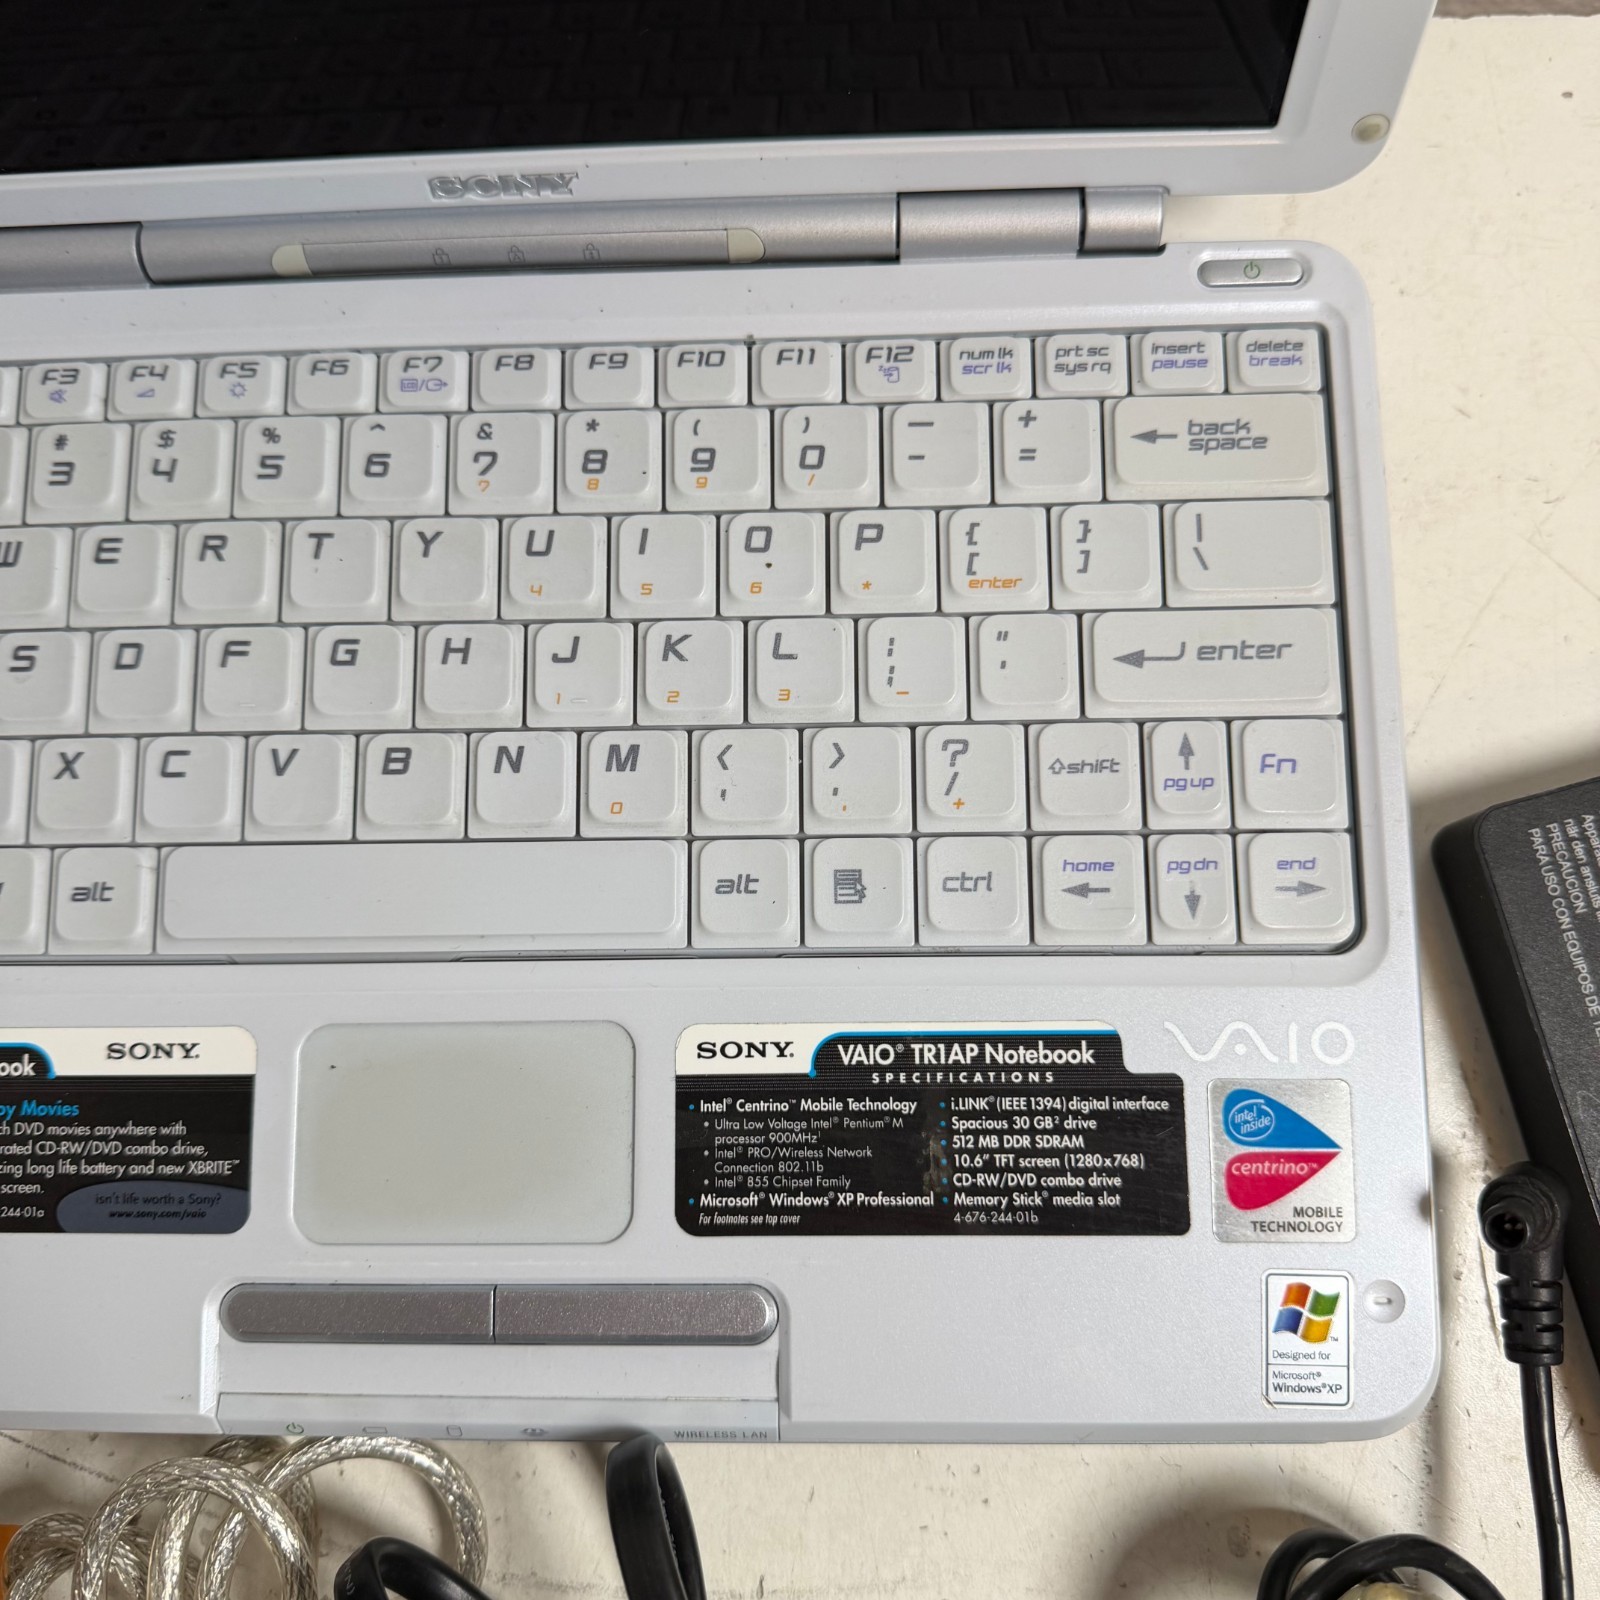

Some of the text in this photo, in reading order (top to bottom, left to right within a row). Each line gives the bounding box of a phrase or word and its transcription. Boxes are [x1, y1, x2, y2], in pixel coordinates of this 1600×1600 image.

[427, 171, 579, 199] SONY
[960, 347, 1013, 360] num lk
[1055, 345, 1109, 360] prt sc
[1151, 342, 1205, 354] insert
[1246, 340, 1304, 352] delete
[495, 354, 535, 371] F8
[589, 352, 628, 369] F9
[678, 350, 725, 367] F10
[777, 348, 815, 365] F11
[866, 346, 914, 363] F12
[1249, 354, 1302, 366] break
[219, 362, 259, 378] F5
[310, 359, 349, 376] F6
[403, 356, 443, 373] F7
[962, 361, 1012, 374] scr lk
[1054, 362, 1111, 375] sys rq
[1152, 359, 1208, 372] pause
[41, 368, 80, 385] F3
[129, 365, 169, 382] F4
[1188, 419, 1250, 436] back
[1188, 435, 1268, 455] space
[417, 531, 443, 558] Y
[526, 530, 555, 556] U
[855, 524, 884, 550] P
[94, 538, 123, 564] E
[199, 535, 228, 561] R
[308, 533, 334, 559] T
[968, 577, 1022, 588] enter
[220, 641, 251, 667] F
[662, 635, 692, 661] K
[1197, 640, 1292, 661] enter
[494, 746, 524, 773] N
[606, 744, 640, 772] M
[1067, 758, 1120, 774] shift
[1260, 754, 1297, 773] Fn
[1164, 778, 1214, 791] pg up
[1563, 818, 1587, 864] när den
[1063, 860, 1115, 872] home
[1167, 858, 1218, 874] pg dn
[1277, 857, 1316, 870] end
[1546, 822, 1587, 914] PRECAUCION
[715, 874, 759, 894] alt
[943, 871, 992, 892] ctrl
[71, 882, 114, 902] alt
[1528, 827, 1594, 995] PARA USO CON EQUIPOS
[1163, 1021, 1355, 1065] VAIO
[911, 1043, 978, 1065] TR1AP
[985, 1041, 1096, 1065] Notebook
[872, 1071, 1054, 1083] SPECIFICATIONS
[20, 1101, 80, 1115] Movies
[801, 1099, 843, 1111] Mobile
[847, 1098, 917, 1114] Technology
[997, 1098, 1028, 1112] (IEEE
[1030, 1097, 1066, 1112] 1394)
[1069, 1096, 1109, 1114] digital
[1113, 1096, 1169, 1111] interface
[1234, 1106, 1257, 1124] intel
[13, 1123, 44, 1135] DVD
[47, 1122, 91, 1135] movies
[93, 1121, 157, 1138] anywhere
[160, 1120, 186, 1134] with
[715, 1119, 740, 1129] Ultra
[744, 1119, 765, 1129] Low
[768, 1119, 807, 1132] Voltage
[892, 1118, 903, 1127] M
[952, 1117, 1008, 1131] Spacious
[1013, 1116, 1029, 1129] 30
[1064, 1116, 1097, 1130] drive
[1240, 1116, 1271, 1134] inside
[715, 1134, 765, 1146] processor
[952, 1135, 1085, 1148] 512 MB DDR SDRAM
[35, 1141, 122, 1156] CD-RW/DVD
[125, 1141, 168, 1155] combo
[171, 1141, 208, 1156] drive,
[748, 1146, 823, 1158] PRO/Wireless
[827, 1147, 872, 1157] Network
[26, 1160, 54, 1177] long
[57, 1160, 78, 1173] life
[81, 1160, 126, 1177] battery
[129, 1160, 154, 1174] and
[157, 1163, 186, 1173] new
[715, 1161, 824, 1172] Connection 802.11b
[994, 1154, 1014, 1167] TFT
[1019, 1156, 1060, 1168] screen
[747, 1177, 769, 1187] 855
[773, 1176, 813, 1190] Chipset
[816, 1176, 851, 1190] Family
[953, 1172, 1122, 1188] CD-RW/DVD combo drive
[1, 1183, 45, 1194] screen.
[123, 1192, 138, 1204] life
[142, 1194, 175, 1204] worth
[178, 1196, 184, 1204] a
[187, 1193, 221, 1207] Sony?
[837, 1193, 854, 1206] XP
[857, 1192, 934, 1206] Professional
[954, 1193, 1008, 1209] Memory
[1053, 1192, 1094, 1205] media
[1098, 1192, 1121, 1205] slot
[109, 1209, 206, 1219] www.sony.com/vaio
[699, 1212, 800, 1226] For footnotes see top cover
[953, 1211, 1038, 1223] 4-676-244-01b
[1293, 1207, 1343, 1218] MOBILE
[1251, 1221, 1344, 1233] TECHNOLOGY
[1272, 1350, 1331, 1361] Designed for
[1327, 1384, 1342, 1393] XP
[673, 1429, 768, 1439] WIRELESS LAN
